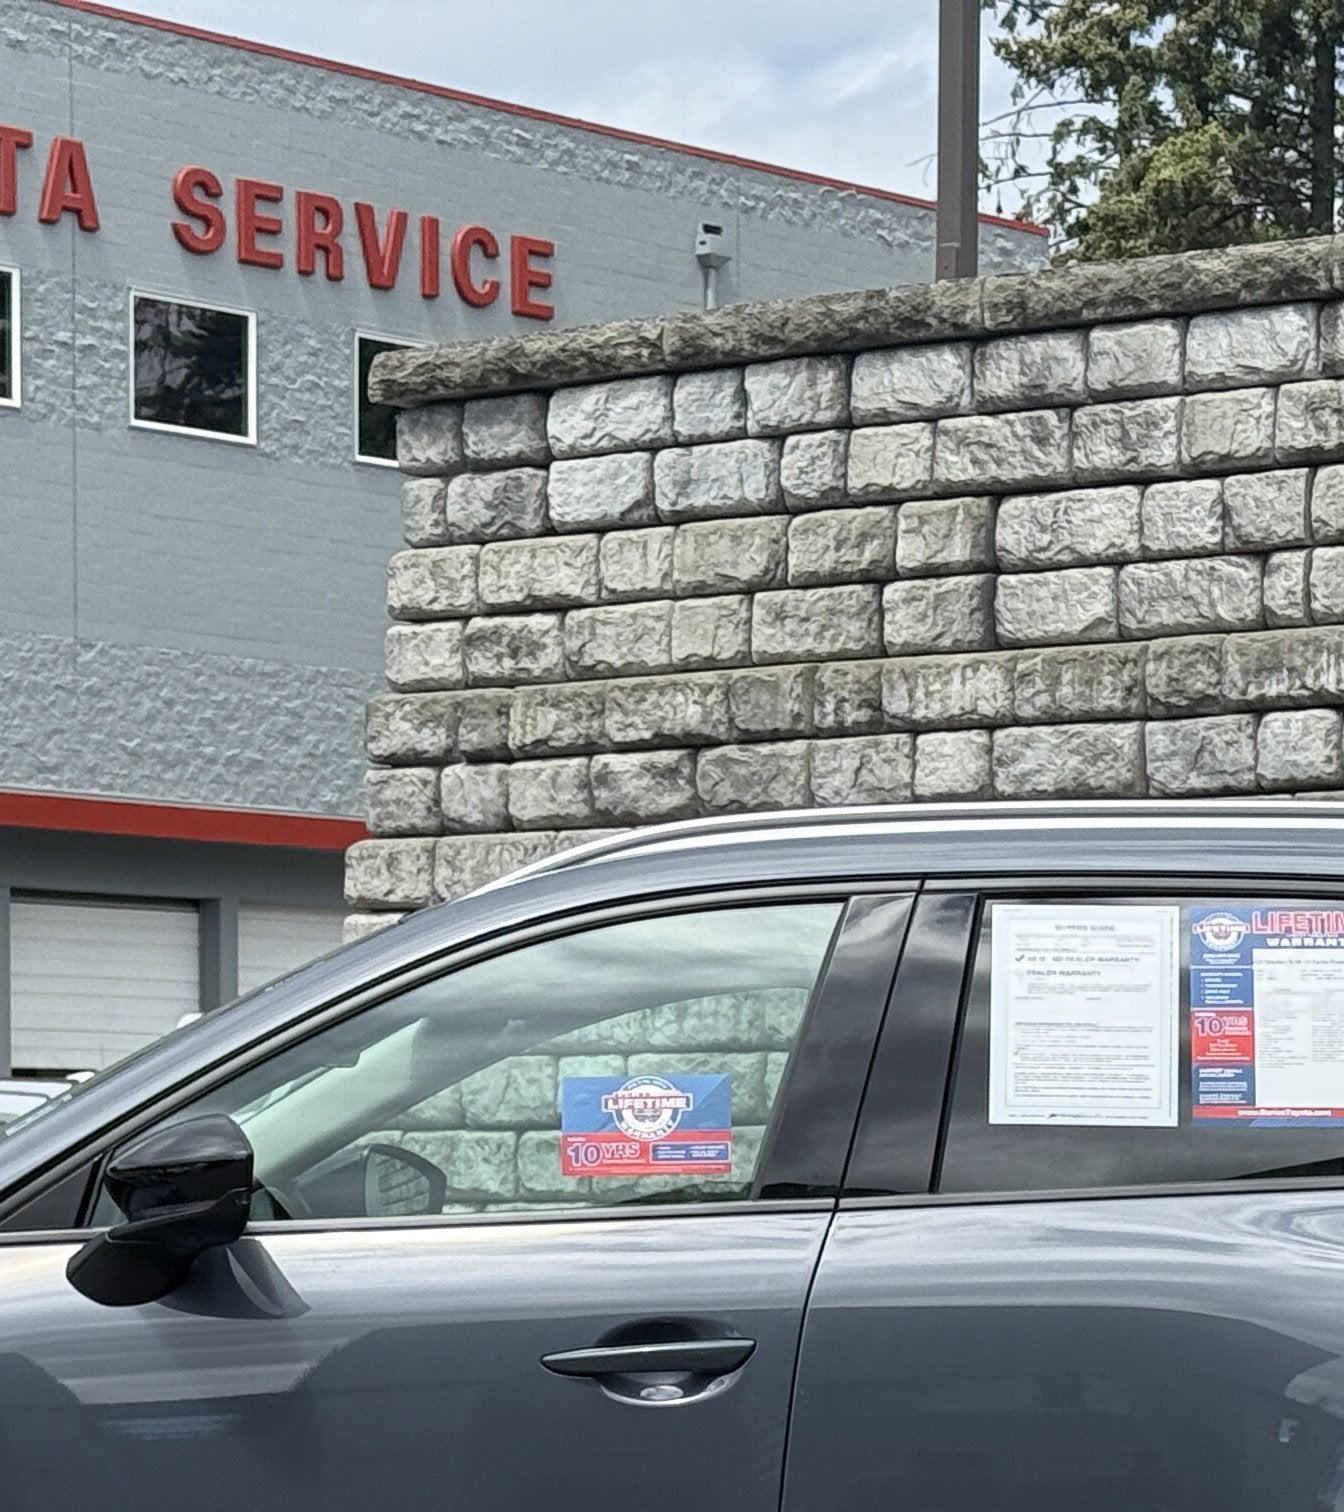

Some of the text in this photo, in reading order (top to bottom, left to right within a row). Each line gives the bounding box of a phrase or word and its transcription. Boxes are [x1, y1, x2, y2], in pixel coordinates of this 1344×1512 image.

[173, 166, 554, 320] SERVICE
[1194, 1017, 1225, 1037] 10
[607, 1097, 687, 1110] LIFETIME
[567, 1142, 603, 1168] 10
